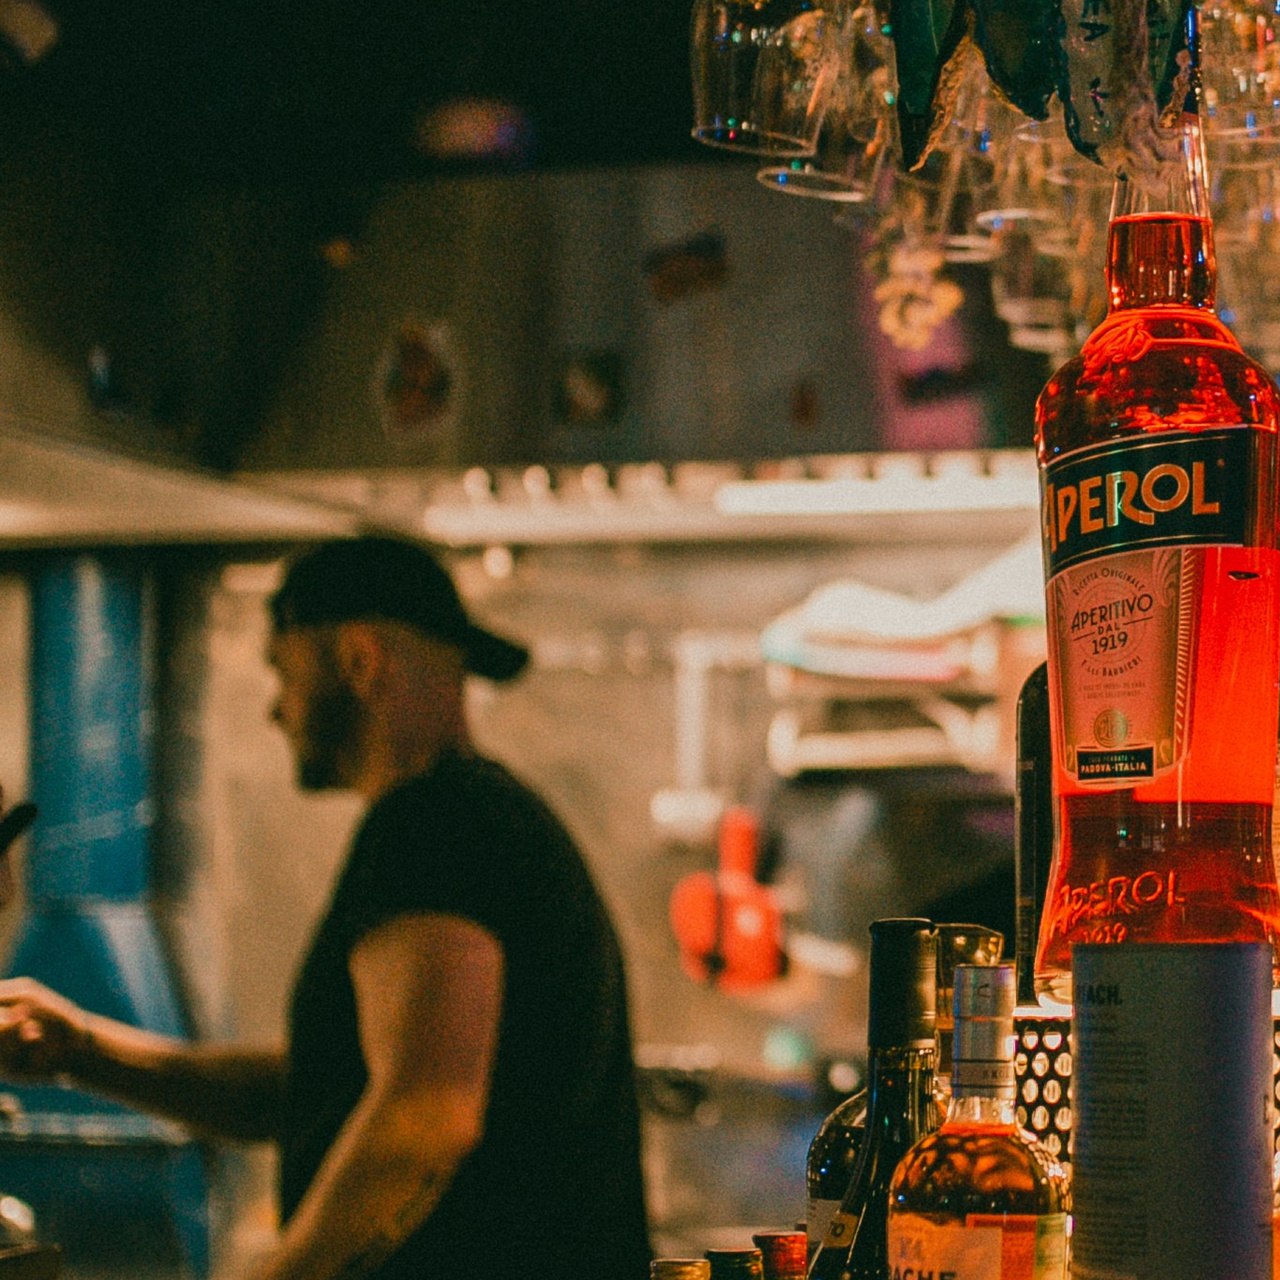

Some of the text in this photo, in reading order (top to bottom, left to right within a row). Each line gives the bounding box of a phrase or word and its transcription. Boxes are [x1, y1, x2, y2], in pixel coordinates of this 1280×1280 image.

[1071, 593, 1153, 634] APERITIVO
[1098, 622, 1120, 636] DAL
[1092, 631, 1128, 655] 1919
